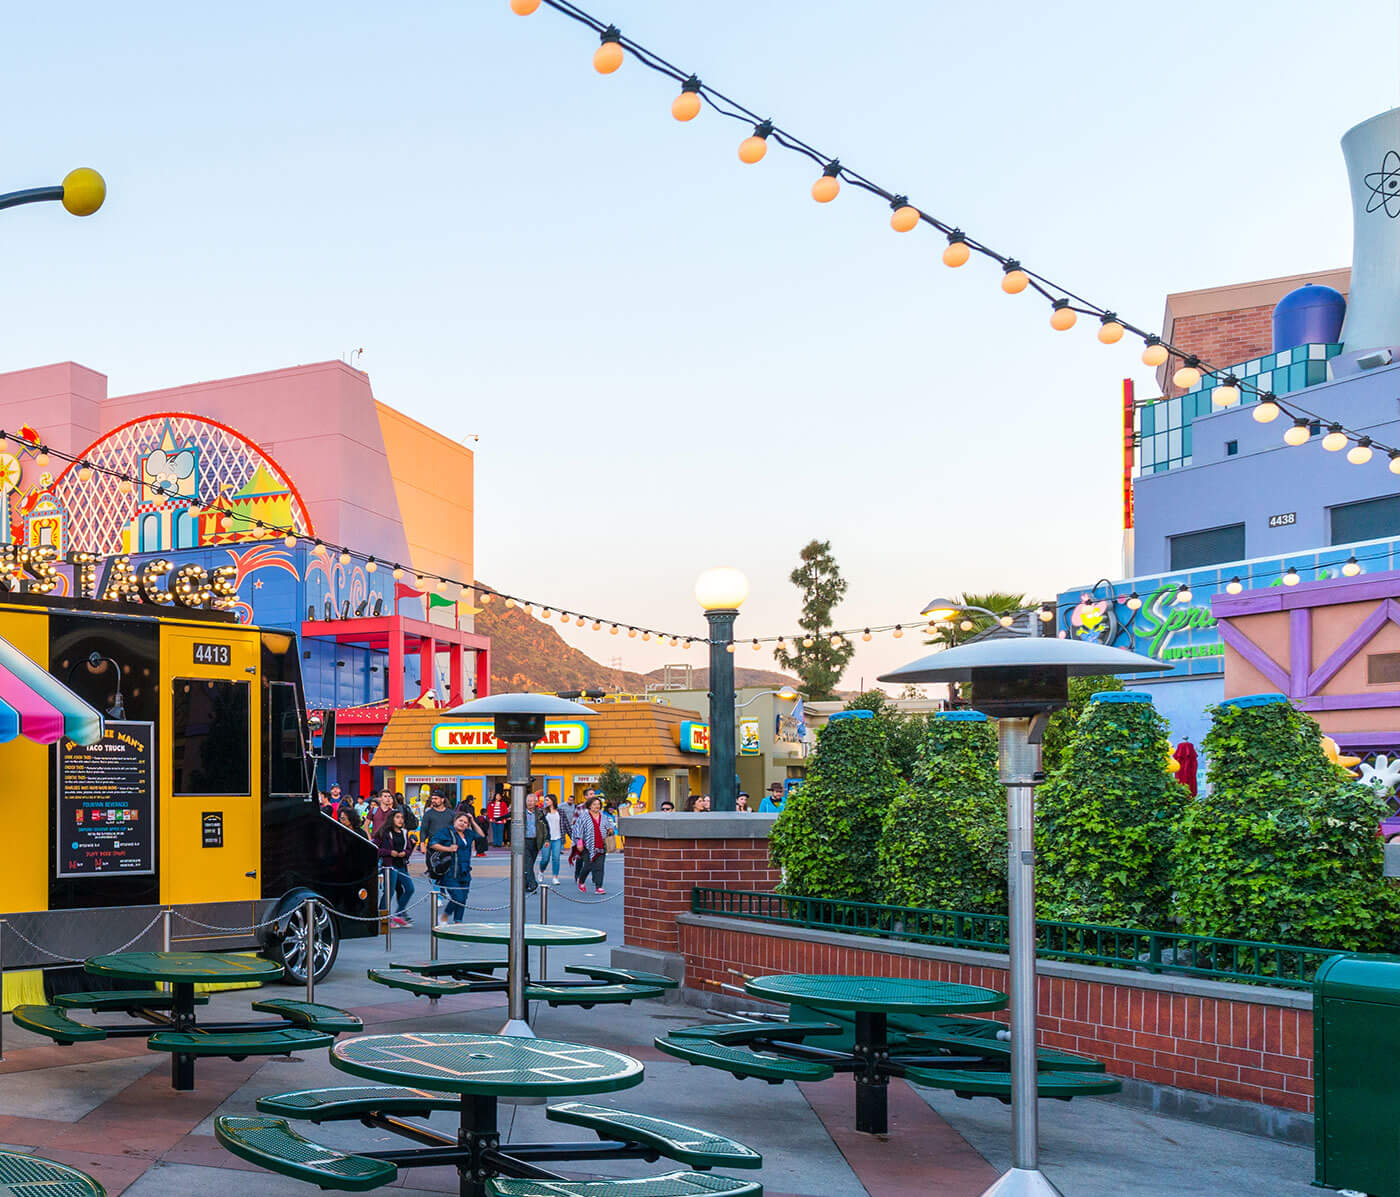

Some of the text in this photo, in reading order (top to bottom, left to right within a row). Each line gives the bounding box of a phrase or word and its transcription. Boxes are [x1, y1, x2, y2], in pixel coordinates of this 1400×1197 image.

[1270, 513, 1295, 526] 4438
[67, 550, 239, 609] TACOS
[195, 645, 228, 664] 4413
[105, 744, 126, 752] TRUCK
